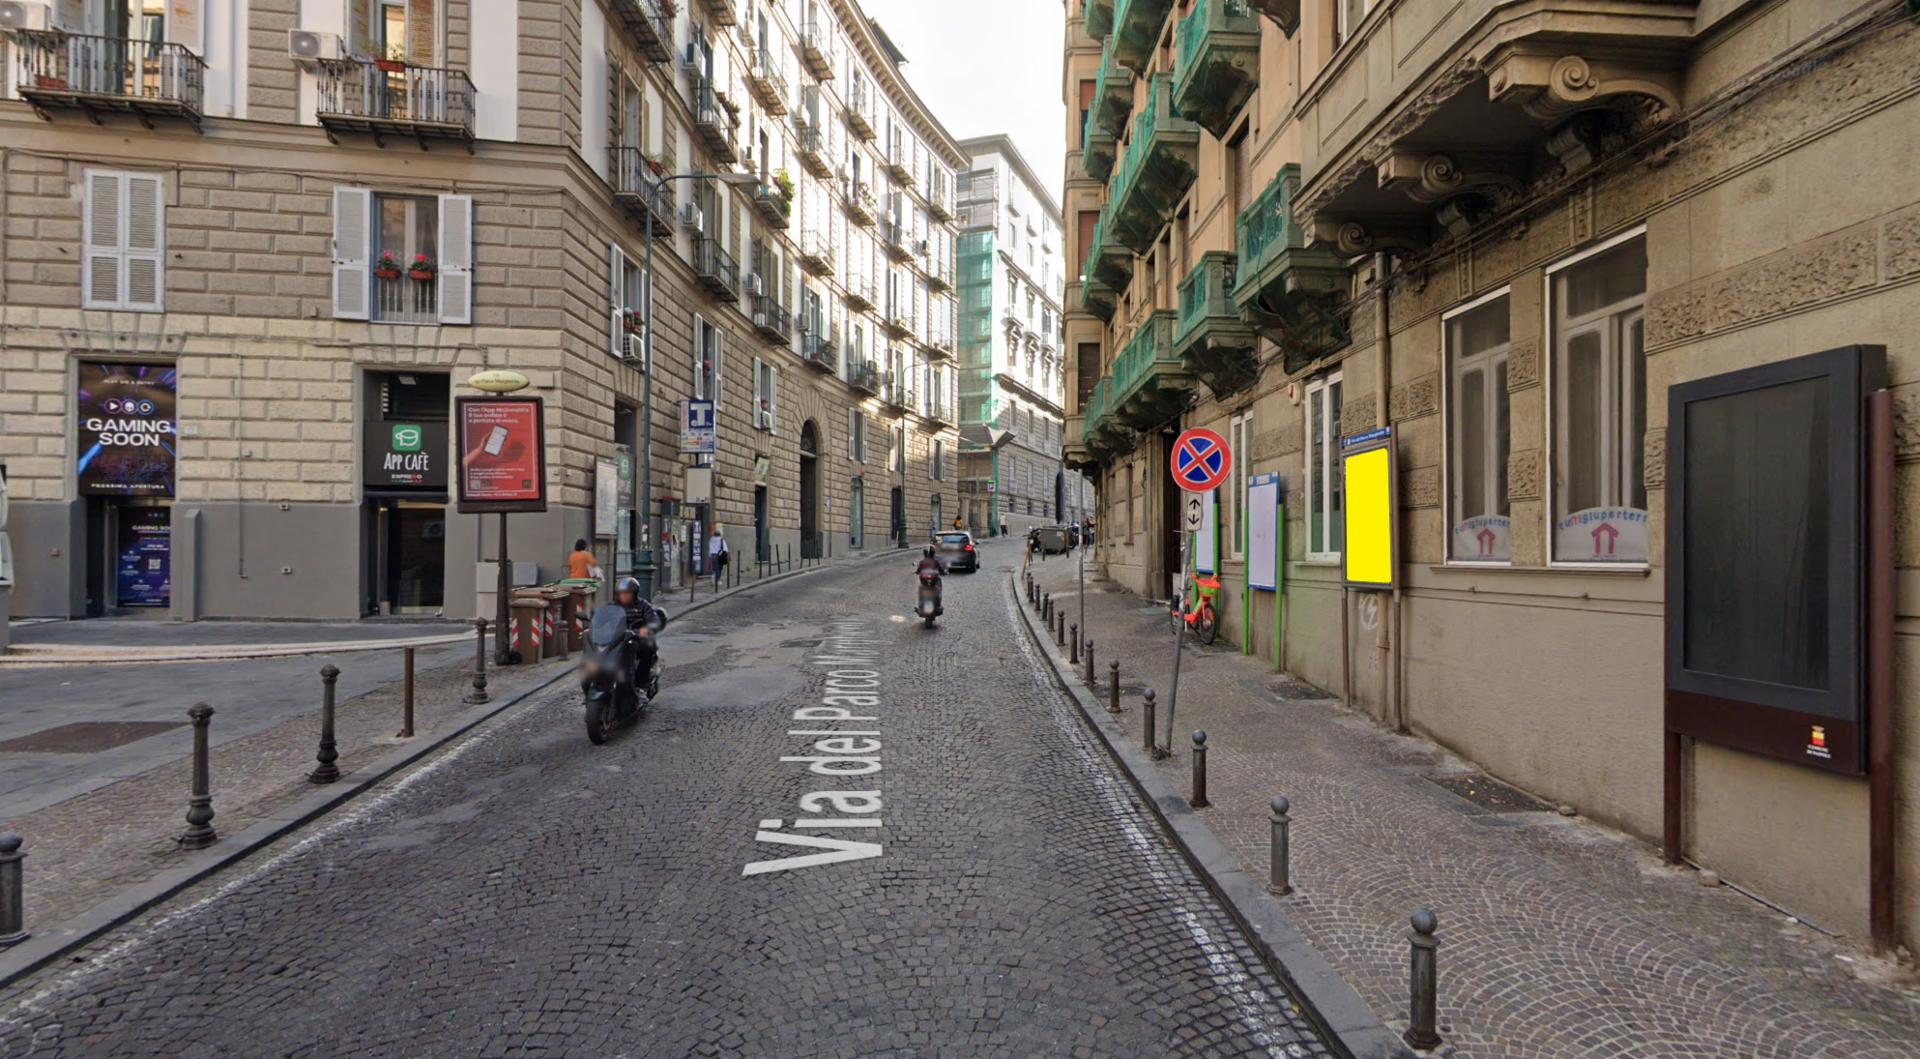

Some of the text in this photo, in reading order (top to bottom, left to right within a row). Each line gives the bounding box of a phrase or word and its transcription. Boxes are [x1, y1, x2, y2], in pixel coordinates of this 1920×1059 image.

[86, 418, 171, 433] GAMING
[99, 433, 159, 446] SOON
[384, 452, 430, 471] APP CAFÈ
